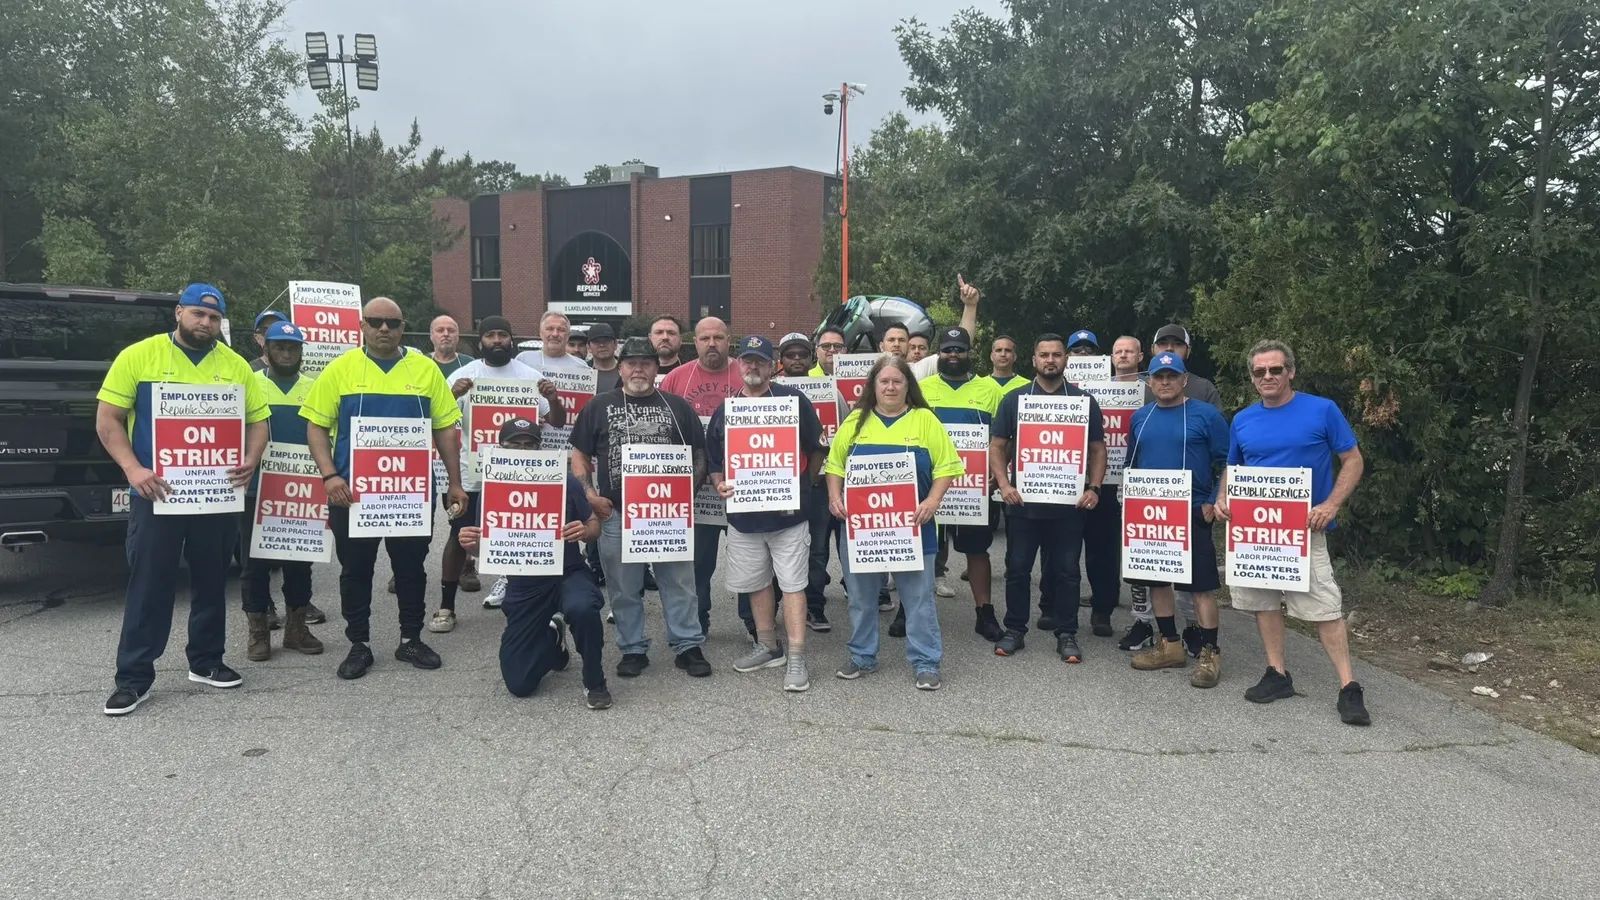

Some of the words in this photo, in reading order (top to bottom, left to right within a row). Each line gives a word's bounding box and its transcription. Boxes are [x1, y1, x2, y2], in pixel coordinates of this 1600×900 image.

[296, 287, 340, 295] EMPLOYEES
[314, 311, 340, 326] ON
[161, 393, 219, 401] EMPLOYEES
[477, 386, 520, 394] EMPLOYEES
[627, 402, 662, 416] Vegas
[725, 416, 760, 425] REPUBLIC
[764, 415, 798, 425] SERVICES
[1018, 413, 1052, 422] REPUBLIC
[1054, 413, 1088, 424] SERVICES
[184, 426, 216, 444] ON
[750, 434, 774, 448] ON
[1039, 430, 1064, 444] ON
[159, 448, 238, 466] STRIKE
[490, 457, 542, 466] EMPLOYEES
[730, 452, 794, 469] STRIKE
[1020, 448, 1082, 464] STRIKE
[378, 456, 406, 472] ON
[850, 462, 894, 471] EMPLOYEES
[356, 476, 426, 492] STRIKE
[1235, 476, 1288, 484] EMPLOYEES
[284, 482, 312, 498] ON
[647, 483, 672, 498] ON
[734, 488, 790, 496] TEAMSTERS
[1228, 485, 1267, 497] REPUBLIC
[1268, 487, 1310, 498] SERVICES
[508, 491, 538, 508] ON
[868, 492, 894, 508] ON
[261, 500, 330, 520] STRIKE
[628, 502, 688, 518] STRIKE
[1144, 506, 1166, 520] ON
[1253, 507, 1282, 524] ON
[486, 511, 558, 529] STRIKE
[851, 511, 915, 530] STRIKE
[262, 526, 290, 534] LABOR
[291, 528, 323, 536] PRACTICE
[1126, 524, 1186, 540] STRIKE
[1232, 527, 1304, 546] STRIKE
[259, 543, 292, 551] LOCAL
[262, 536, 323, 546] TEAMSTERS
[857, 548, 914, 556] TEAMSTERS
[1236, 552, 1260, 560] LABOR
[1262, 554, 1299, 562] PRACTICE
[1130, 557, 1182, 566] TEAMSTERS
[1236, 564, 1300, 574] TEAMSTERS
[1234, 571, 1268, 580] LOCAL
[1272, 573, 1302, 582] No.25
